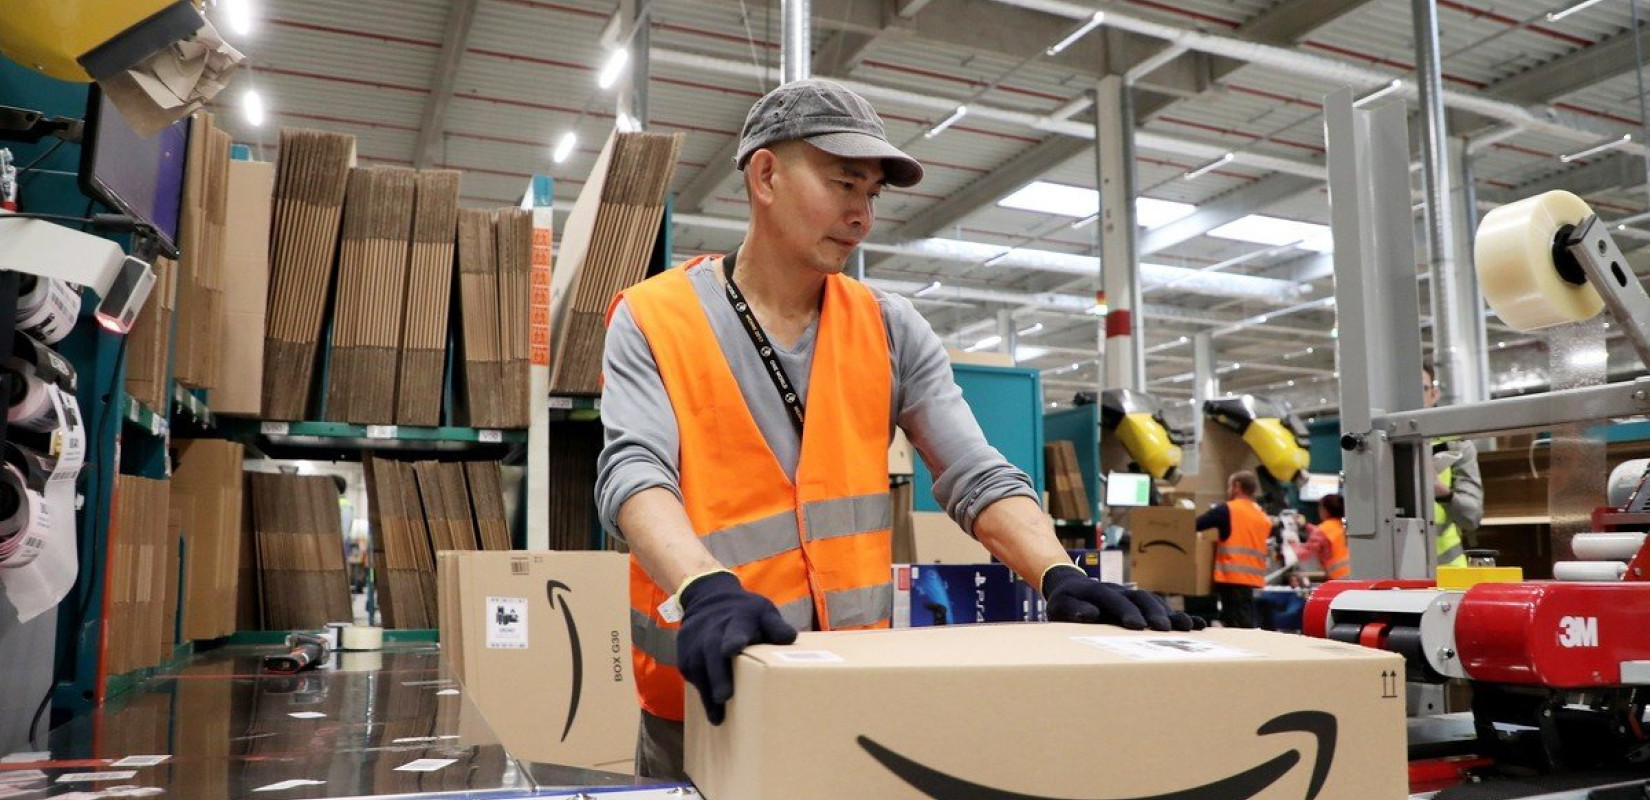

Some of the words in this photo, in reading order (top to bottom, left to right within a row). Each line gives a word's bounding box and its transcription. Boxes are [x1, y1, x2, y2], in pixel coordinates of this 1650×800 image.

[776, 370, 789, 389] WORLD
[976, 590, 985, 622] PS4
[611, 630, 621, 653] G30
[1558, 616, 1599, 648] 3M
[613, 656, 623, 682] BOX
